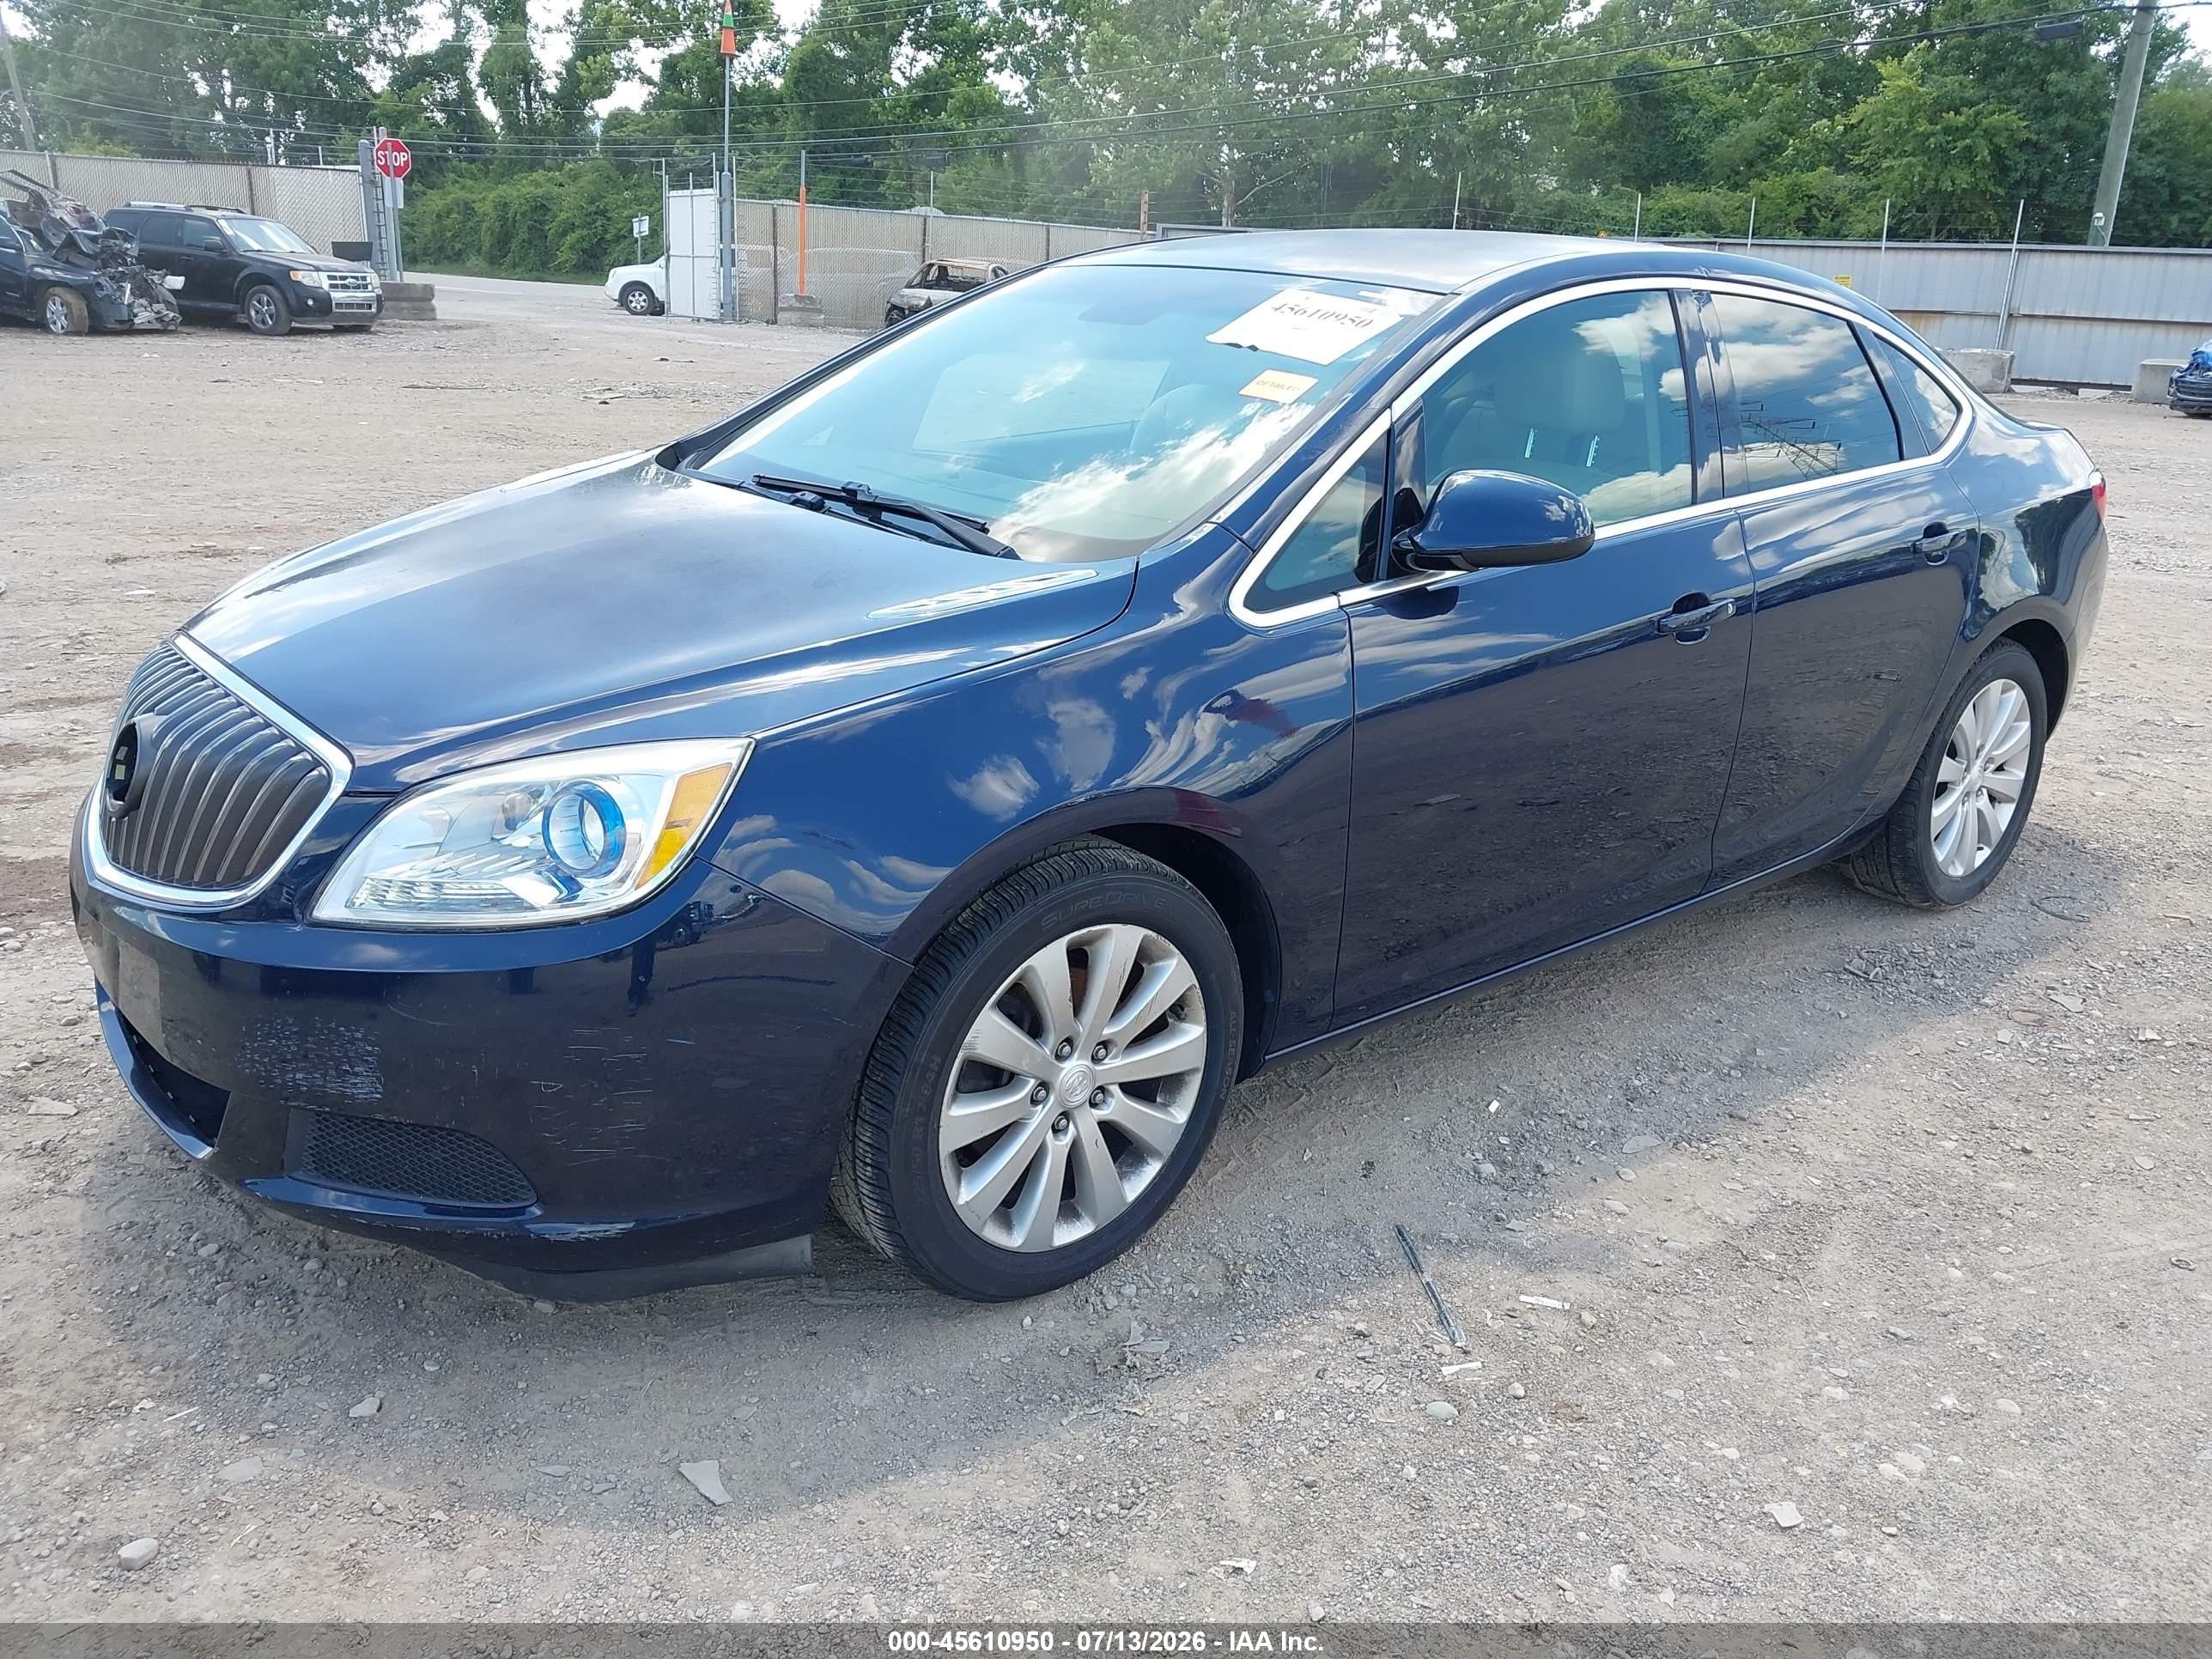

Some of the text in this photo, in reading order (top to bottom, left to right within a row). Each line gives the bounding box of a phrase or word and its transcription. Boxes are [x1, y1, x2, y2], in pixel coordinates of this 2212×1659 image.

[377, 150, 408, 167] STOP
[1270, 302, 1374, 328] 45610950
[1218, 1009, 1237, 1101] ALL-SEASON
